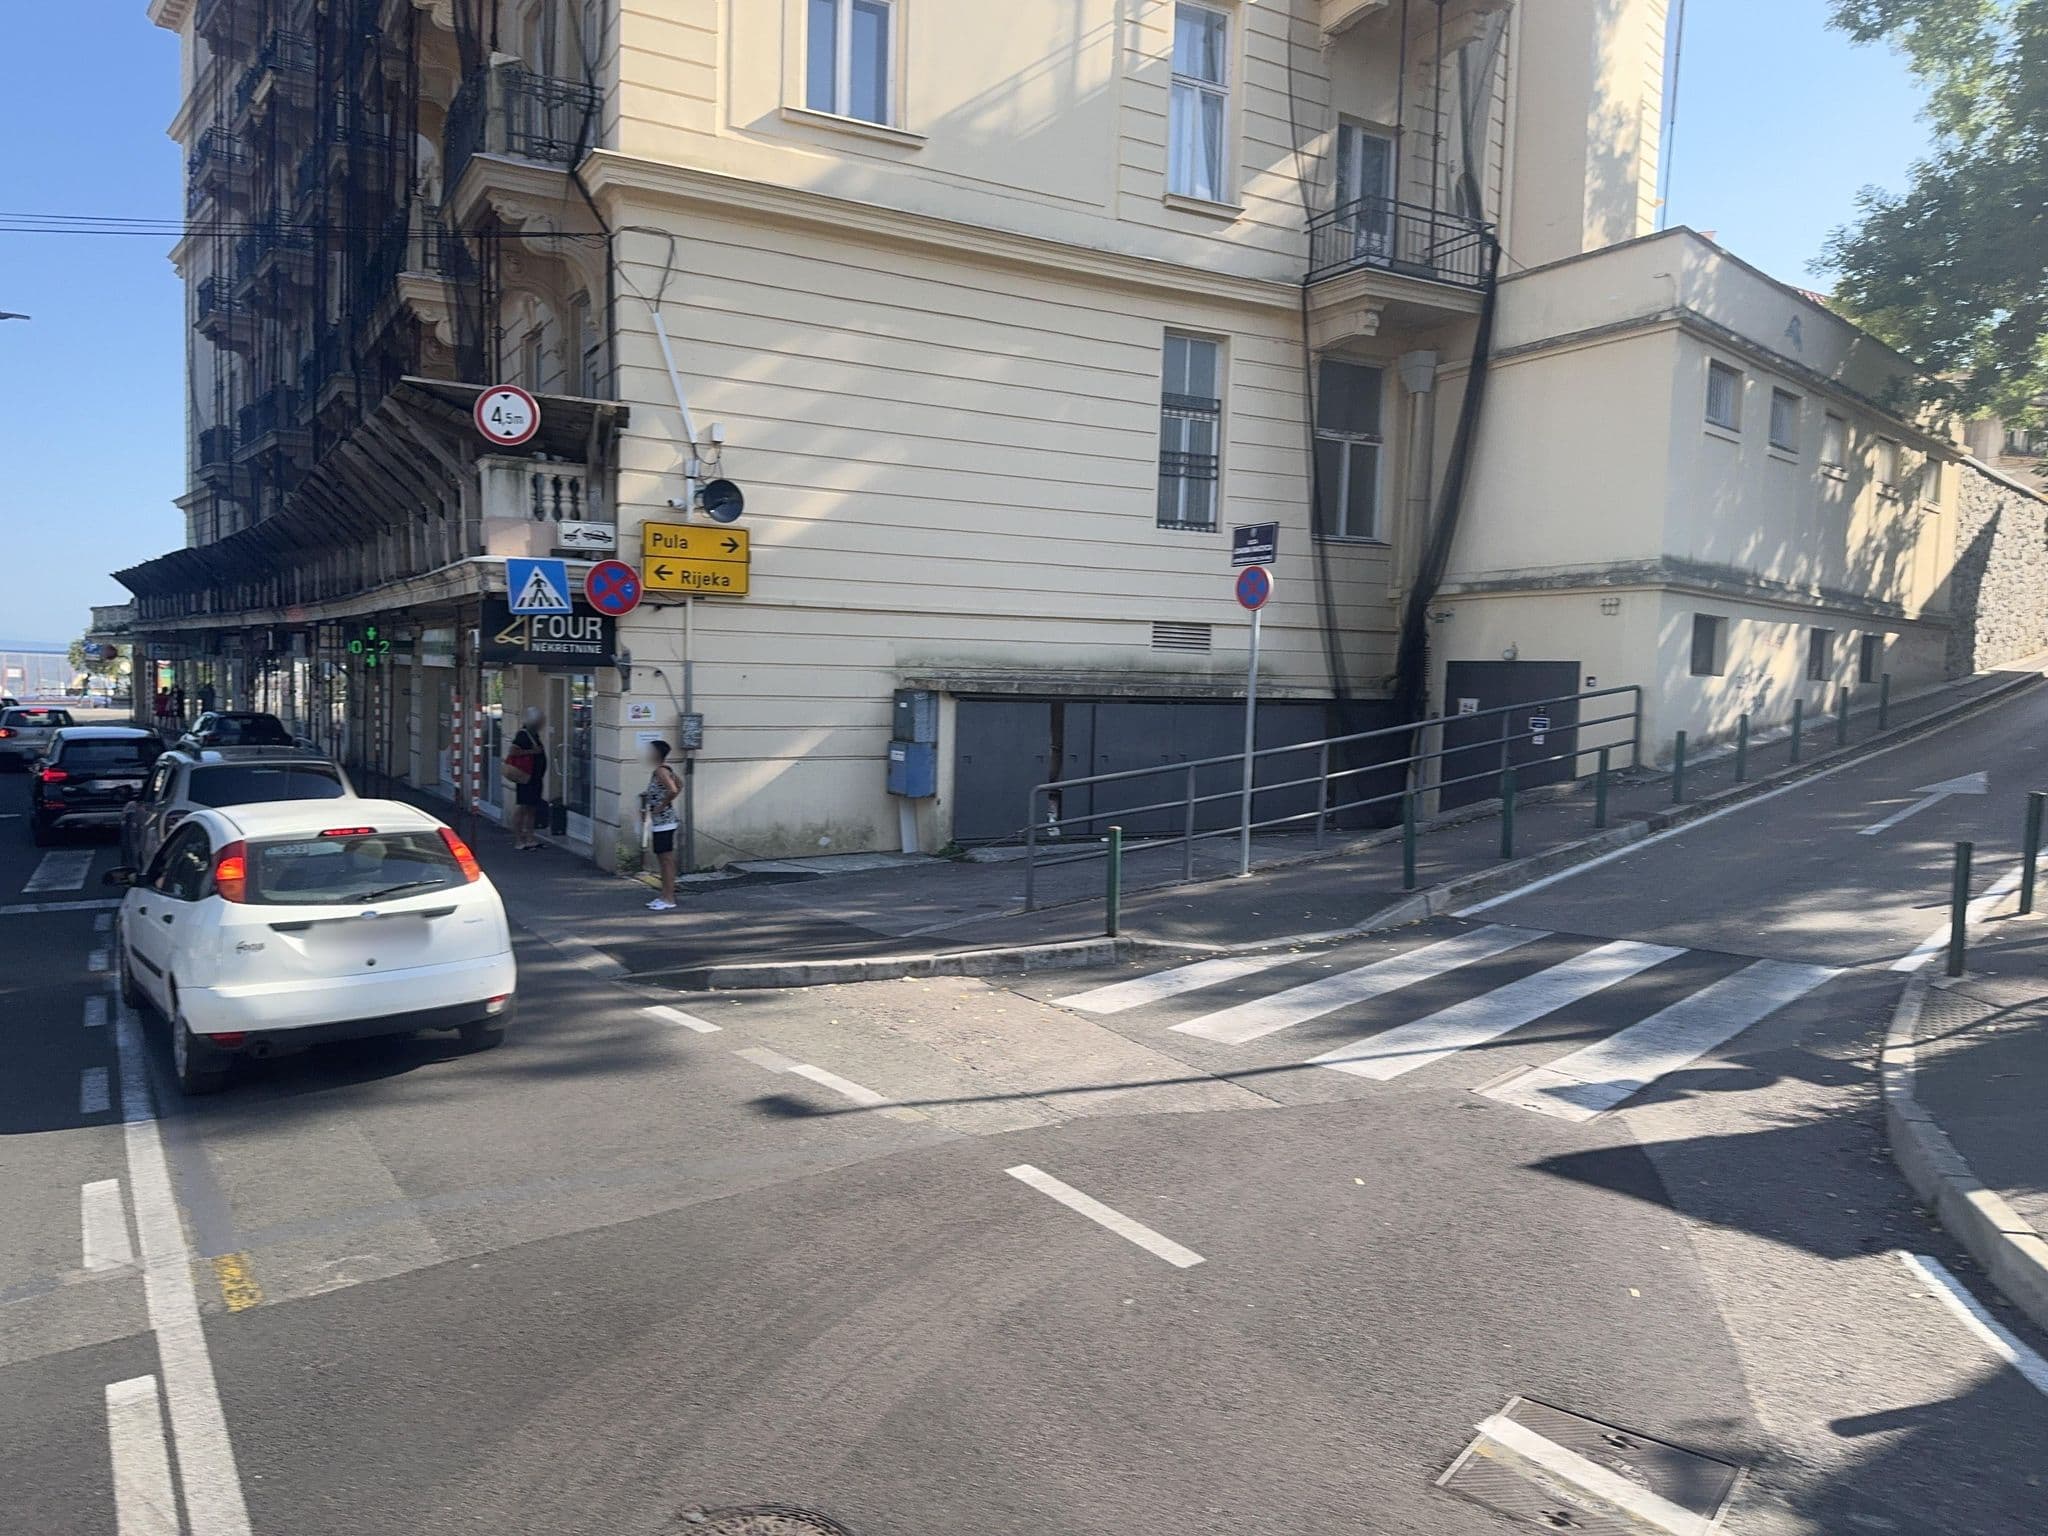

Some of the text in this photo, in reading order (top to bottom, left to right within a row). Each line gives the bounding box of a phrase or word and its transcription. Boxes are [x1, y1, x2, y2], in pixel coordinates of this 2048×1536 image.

[652, 532, 688, 549] Pula
[680, 570, 730, 588] Rijeka
[532, 615, 602, 639] FOUR
[531, 642, 602, 654] NEKRETNINE
